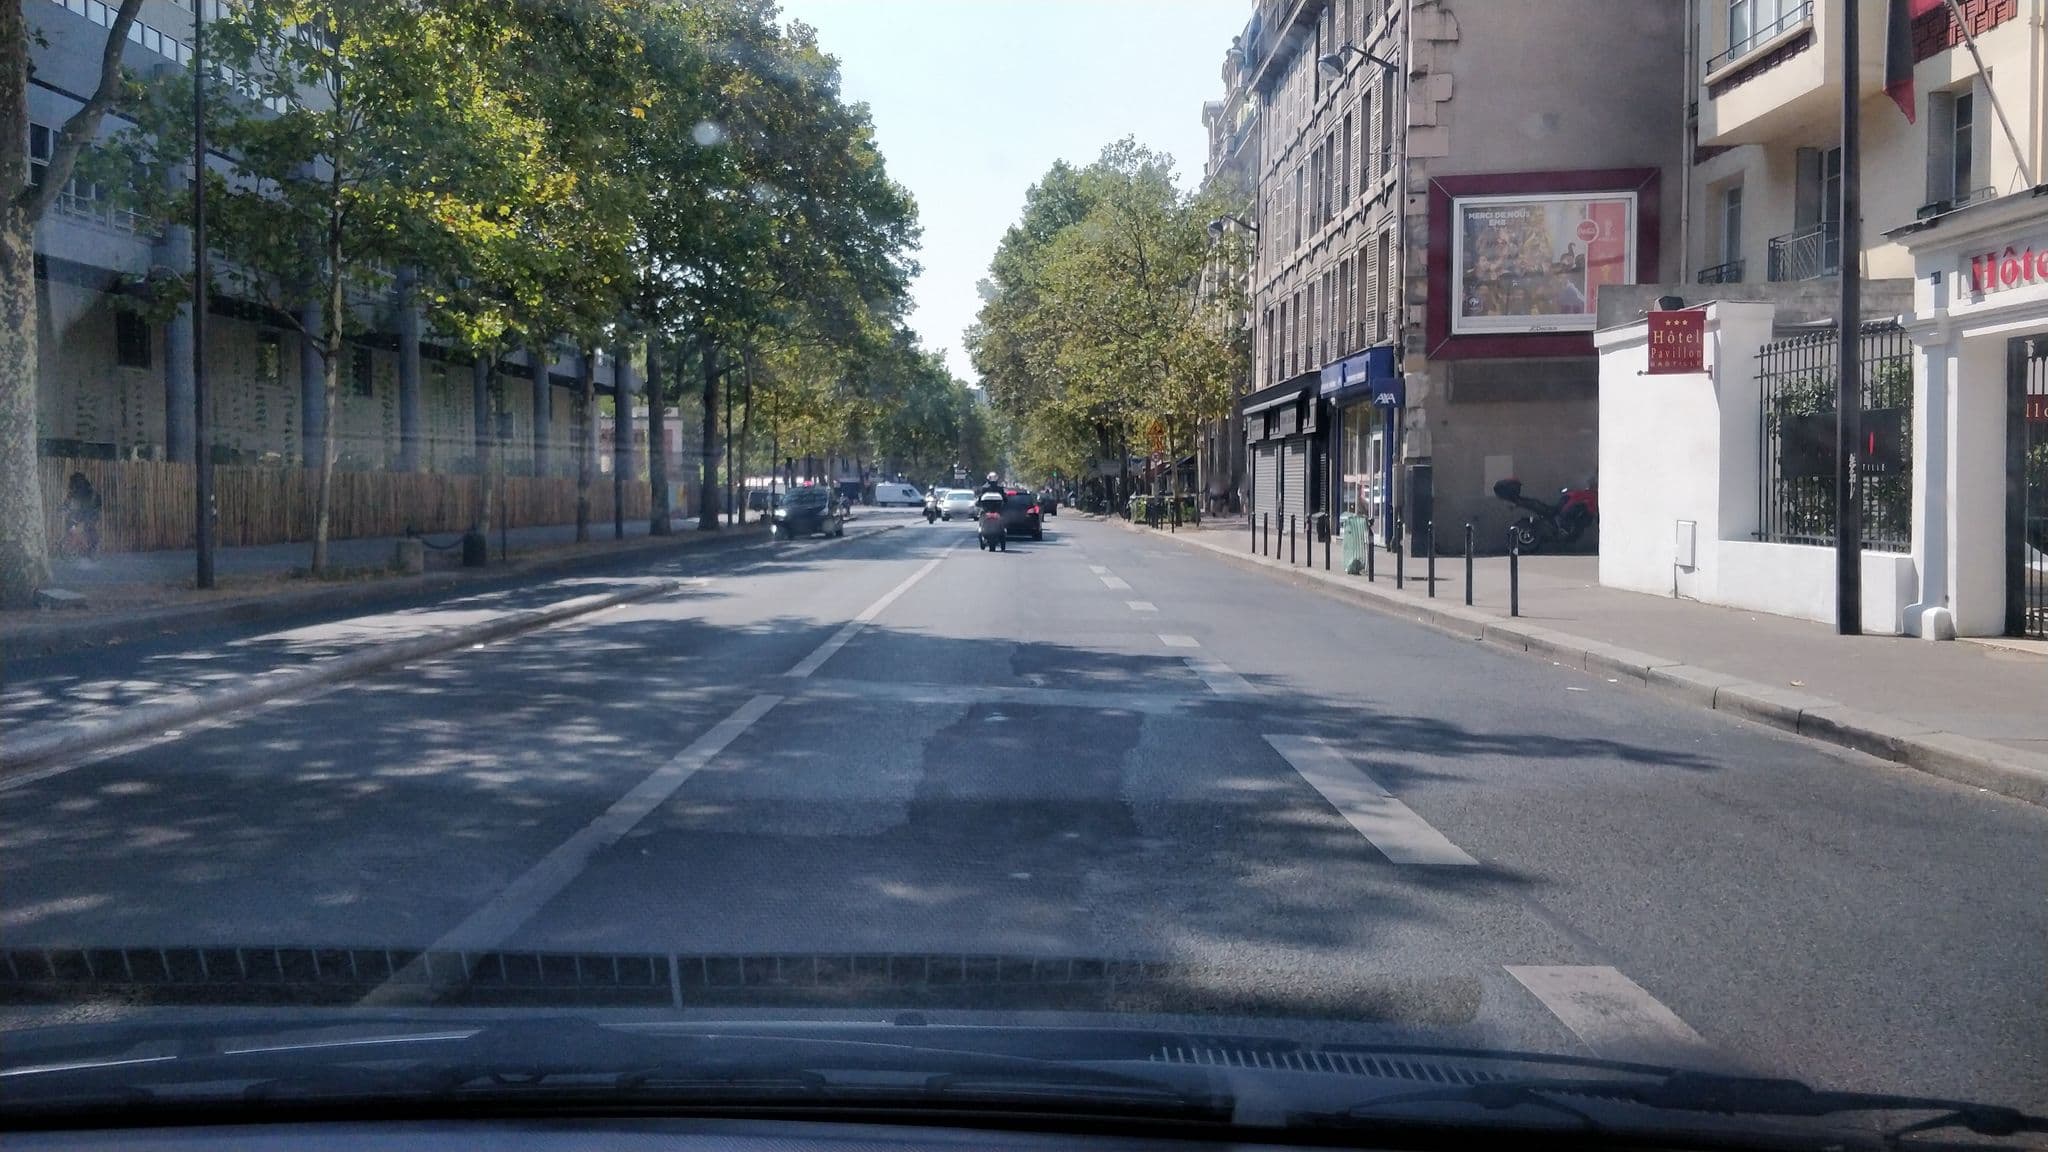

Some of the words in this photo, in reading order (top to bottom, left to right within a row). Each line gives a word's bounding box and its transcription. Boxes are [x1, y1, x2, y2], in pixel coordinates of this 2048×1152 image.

[1653, 329, 1699, 344] Hôtel
[1651, 347, 1702, 358] Pavillon
[1374, 393, 1396, 404] AXA
